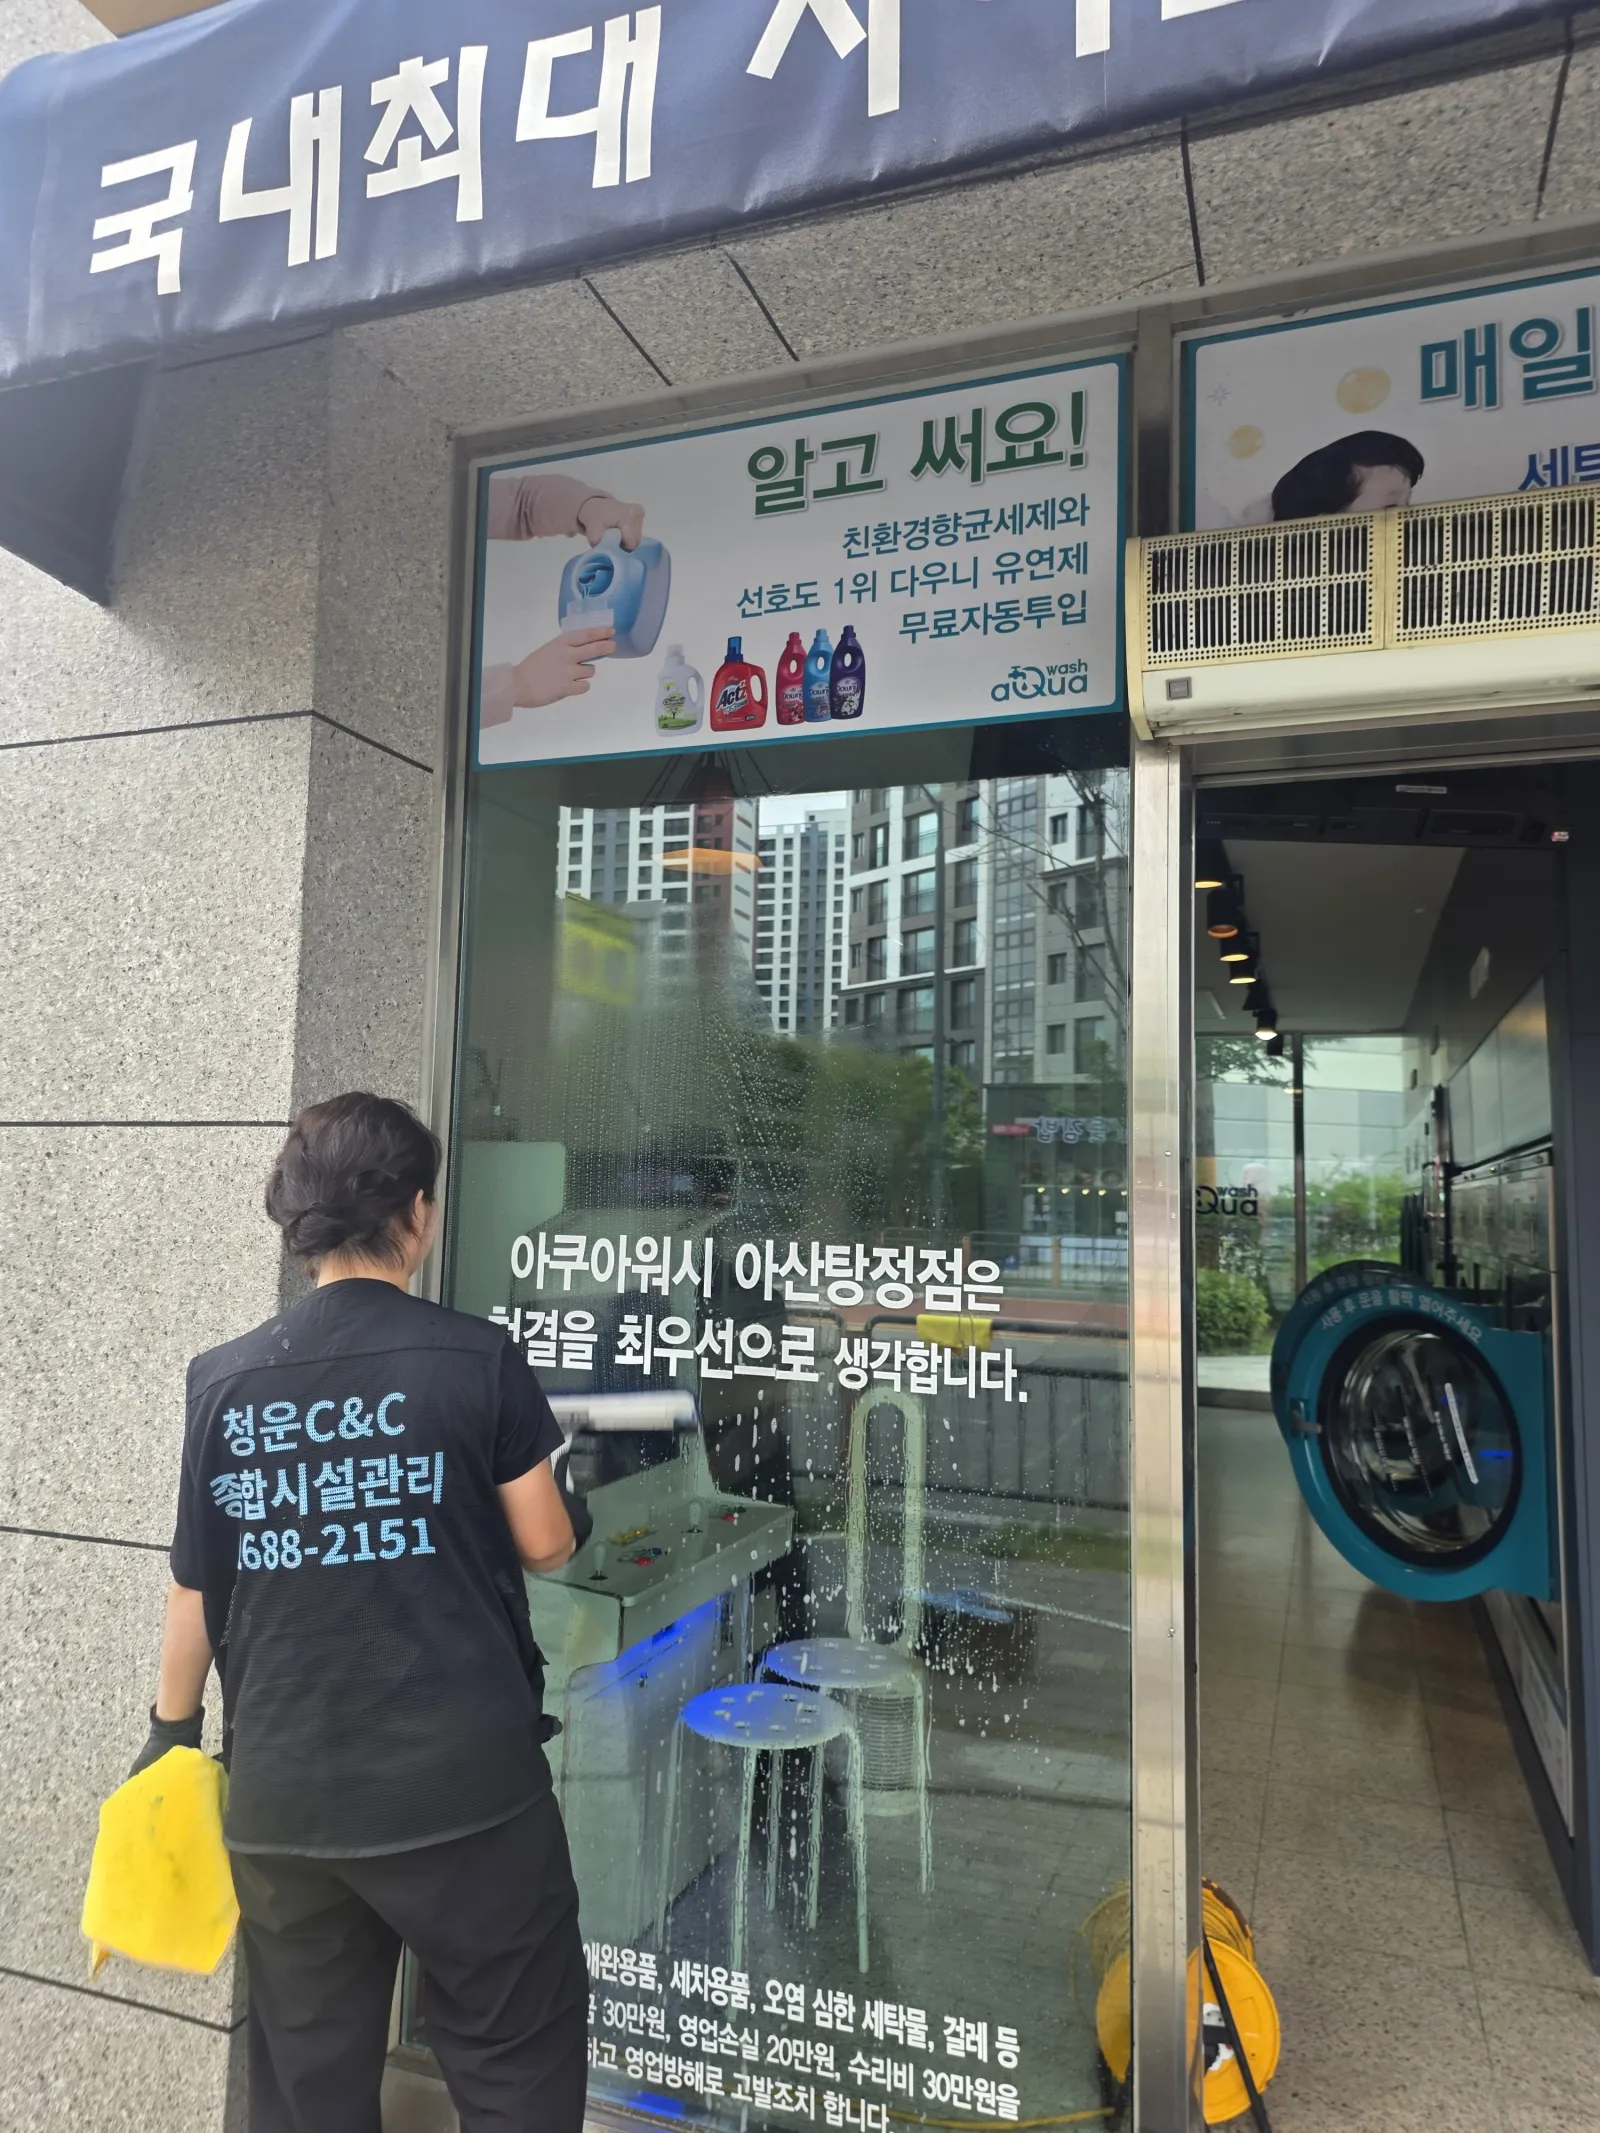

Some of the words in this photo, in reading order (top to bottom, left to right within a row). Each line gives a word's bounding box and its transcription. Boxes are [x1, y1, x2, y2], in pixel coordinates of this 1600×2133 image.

[90, 4, 662, 294] 국내최대
[1420, 306, 1594, 408] 매일
[747, 432, 885, 516] 알고
[909, 389, 1086, 483] 써요!
[843, 493, 1090, 559] 친환경향균세제와
[736, 581, 821, 619] 선호도
[834, 570, 877, 605] 1위
[890, 556, 979, 598] 다우니
[992, 541, 1089, 585] 유연제
[899, 589, 1087, 644] 무료자동투입
[1046, 658, 1088, 676] wash
[1216, 1184, 1258, 1198] wash
[511, 1231, 714, 1298] 아쿠아워시
[735, 1239, 1004, 1312] 아산탕정점은
[614, 1313, 819, 1383] 최우선으로
[834, 1337, 1028, 1403] 생각합니다.
[209, 1452, 444, 1520] 종합시설관리
[670, 1960, 756, 2014] 세차용품,
[763, 1979, 804, 2023] 오염
[812, 1988, 856, 2033] 심한
[861, 1999, 935, 2053] 세탁물,
[943, 2015, 988, 2063] 걸레
[995, 2026, 1020, 2069] 등
[602, 1998, 671, 2043] 30만원,
[678, 2013, 760, 2061] 영업손실
[766, 2035, 841, 2082] 20만원,
[848, 2051, 914, 2097] 수리비
[922, 2069, 1021, 2121] 30만원을
[625, 2042, 725, 2096] 영업방해로
[730, 2070, 815, 2120] 고발조치
